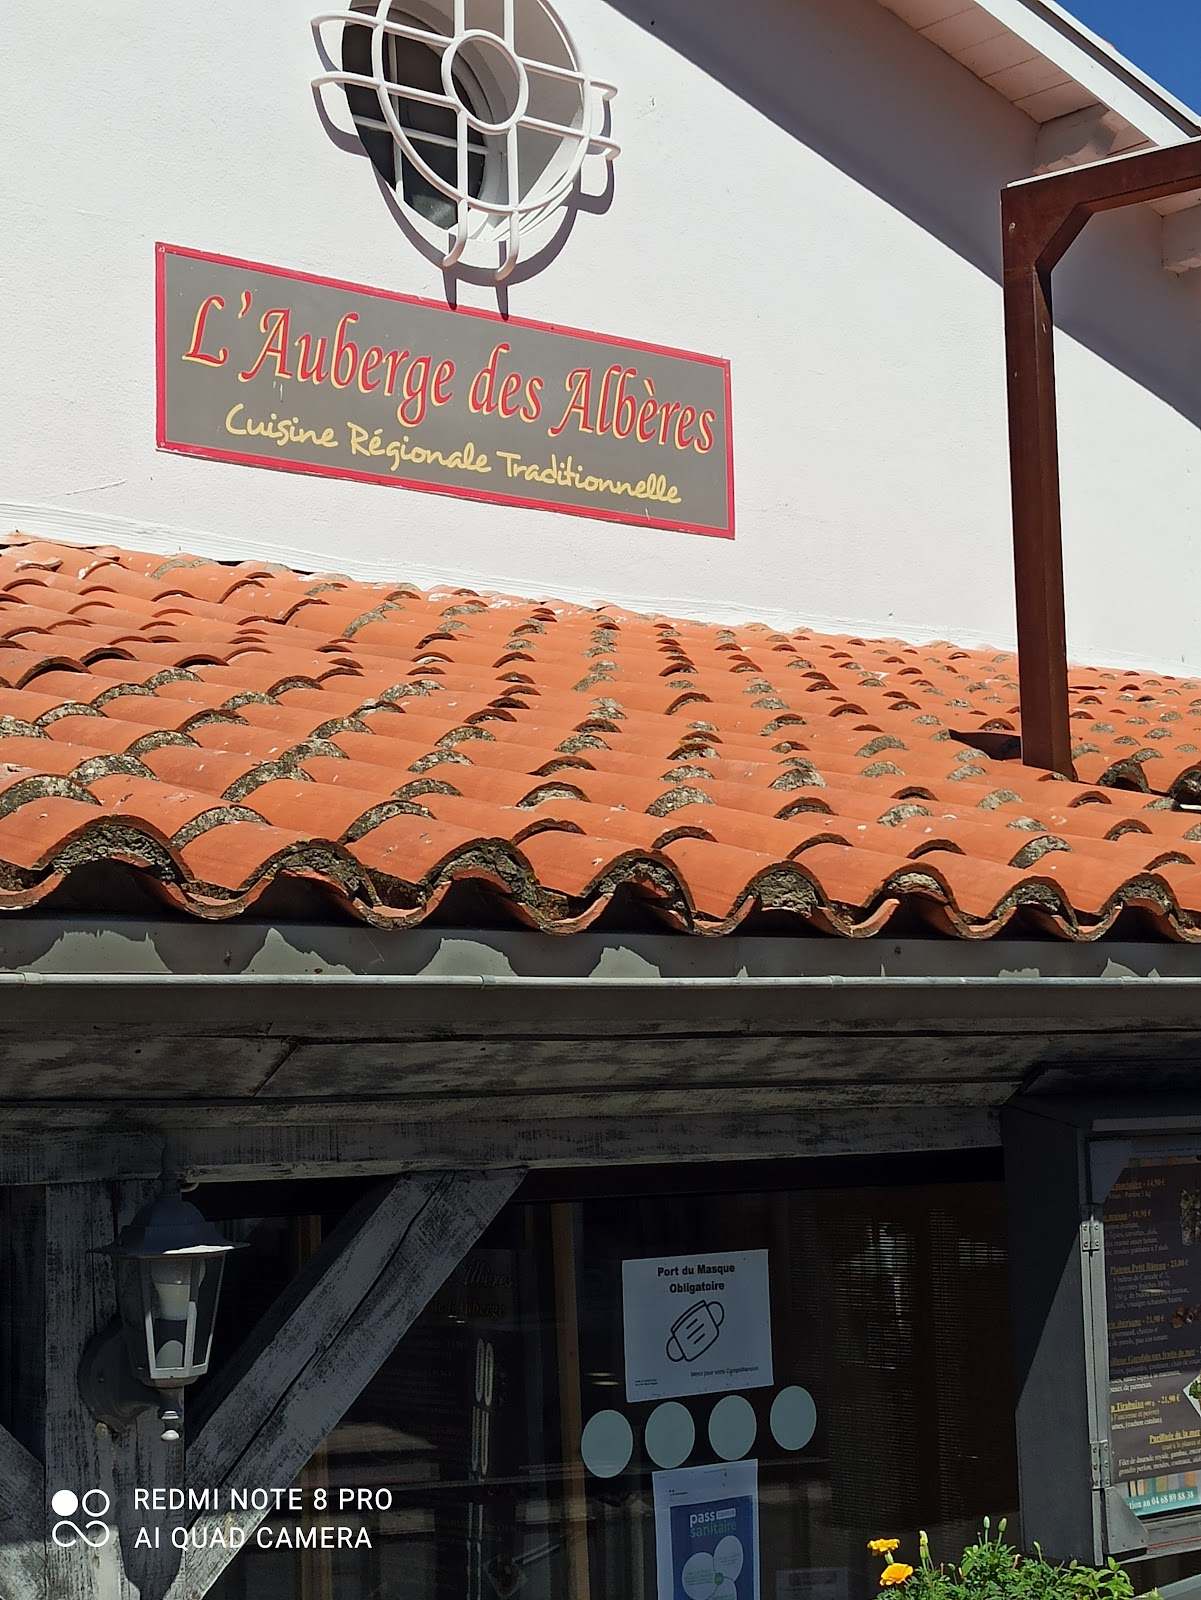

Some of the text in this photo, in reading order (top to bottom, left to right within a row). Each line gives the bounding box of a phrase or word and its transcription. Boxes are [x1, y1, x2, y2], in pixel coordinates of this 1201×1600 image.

[182, 290, 717, 455] L'Auberge des Albères
[223, 402, 682, 506] Cuisine Régionale Traditionnelle
[657, 1263, 735, 1277] Port du Masque
[669, 1280, 725, 1295] Obligatoire
[1151, 1496, 1160, 1506] 04
[689, 1511, 716, 1528] pass
[689, 1521, 737, 1538] sanitaire
